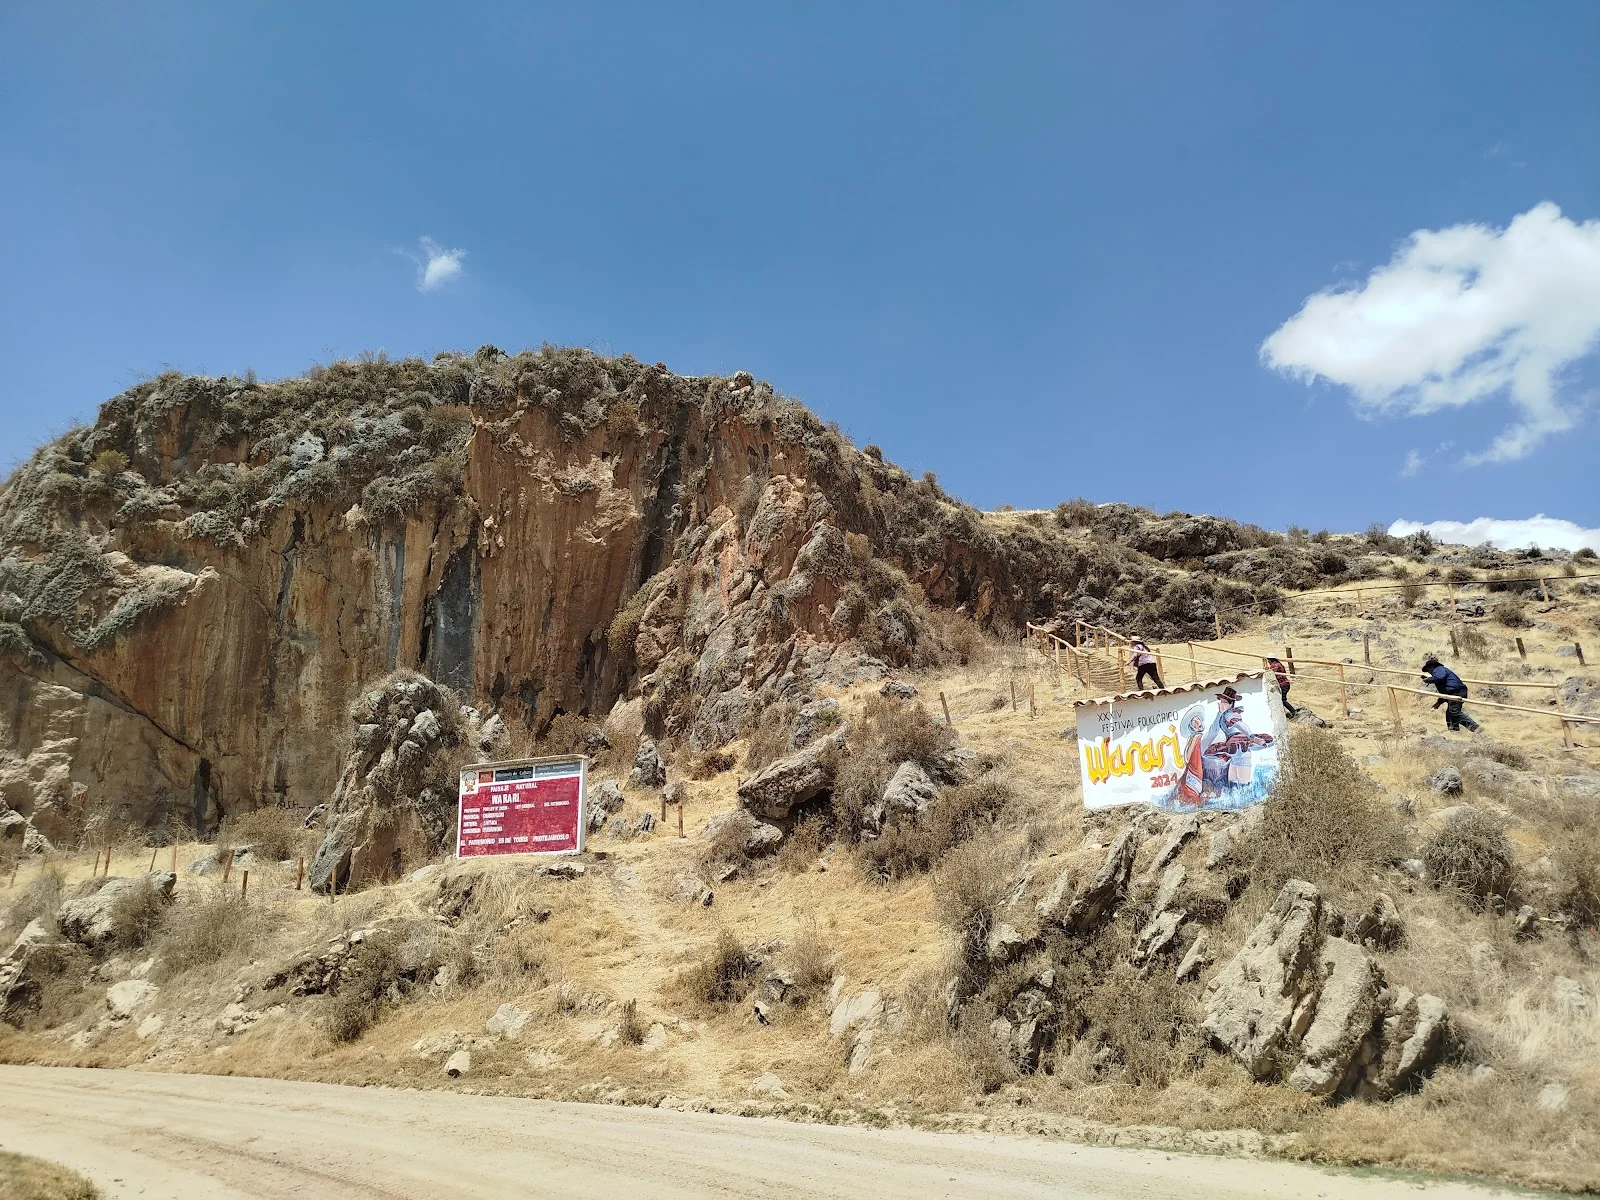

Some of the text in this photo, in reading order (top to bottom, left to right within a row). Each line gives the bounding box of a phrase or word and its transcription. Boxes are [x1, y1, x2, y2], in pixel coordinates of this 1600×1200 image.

[1097, 710, 1123, 722] XXXIV
[1102, 720, 1136, 732] FESTIVAL
[1086, 724, 1186, 785] Warari
[516, 782, 538, 790] NATURAL
[1150, 772, 1178, 789] 2024
